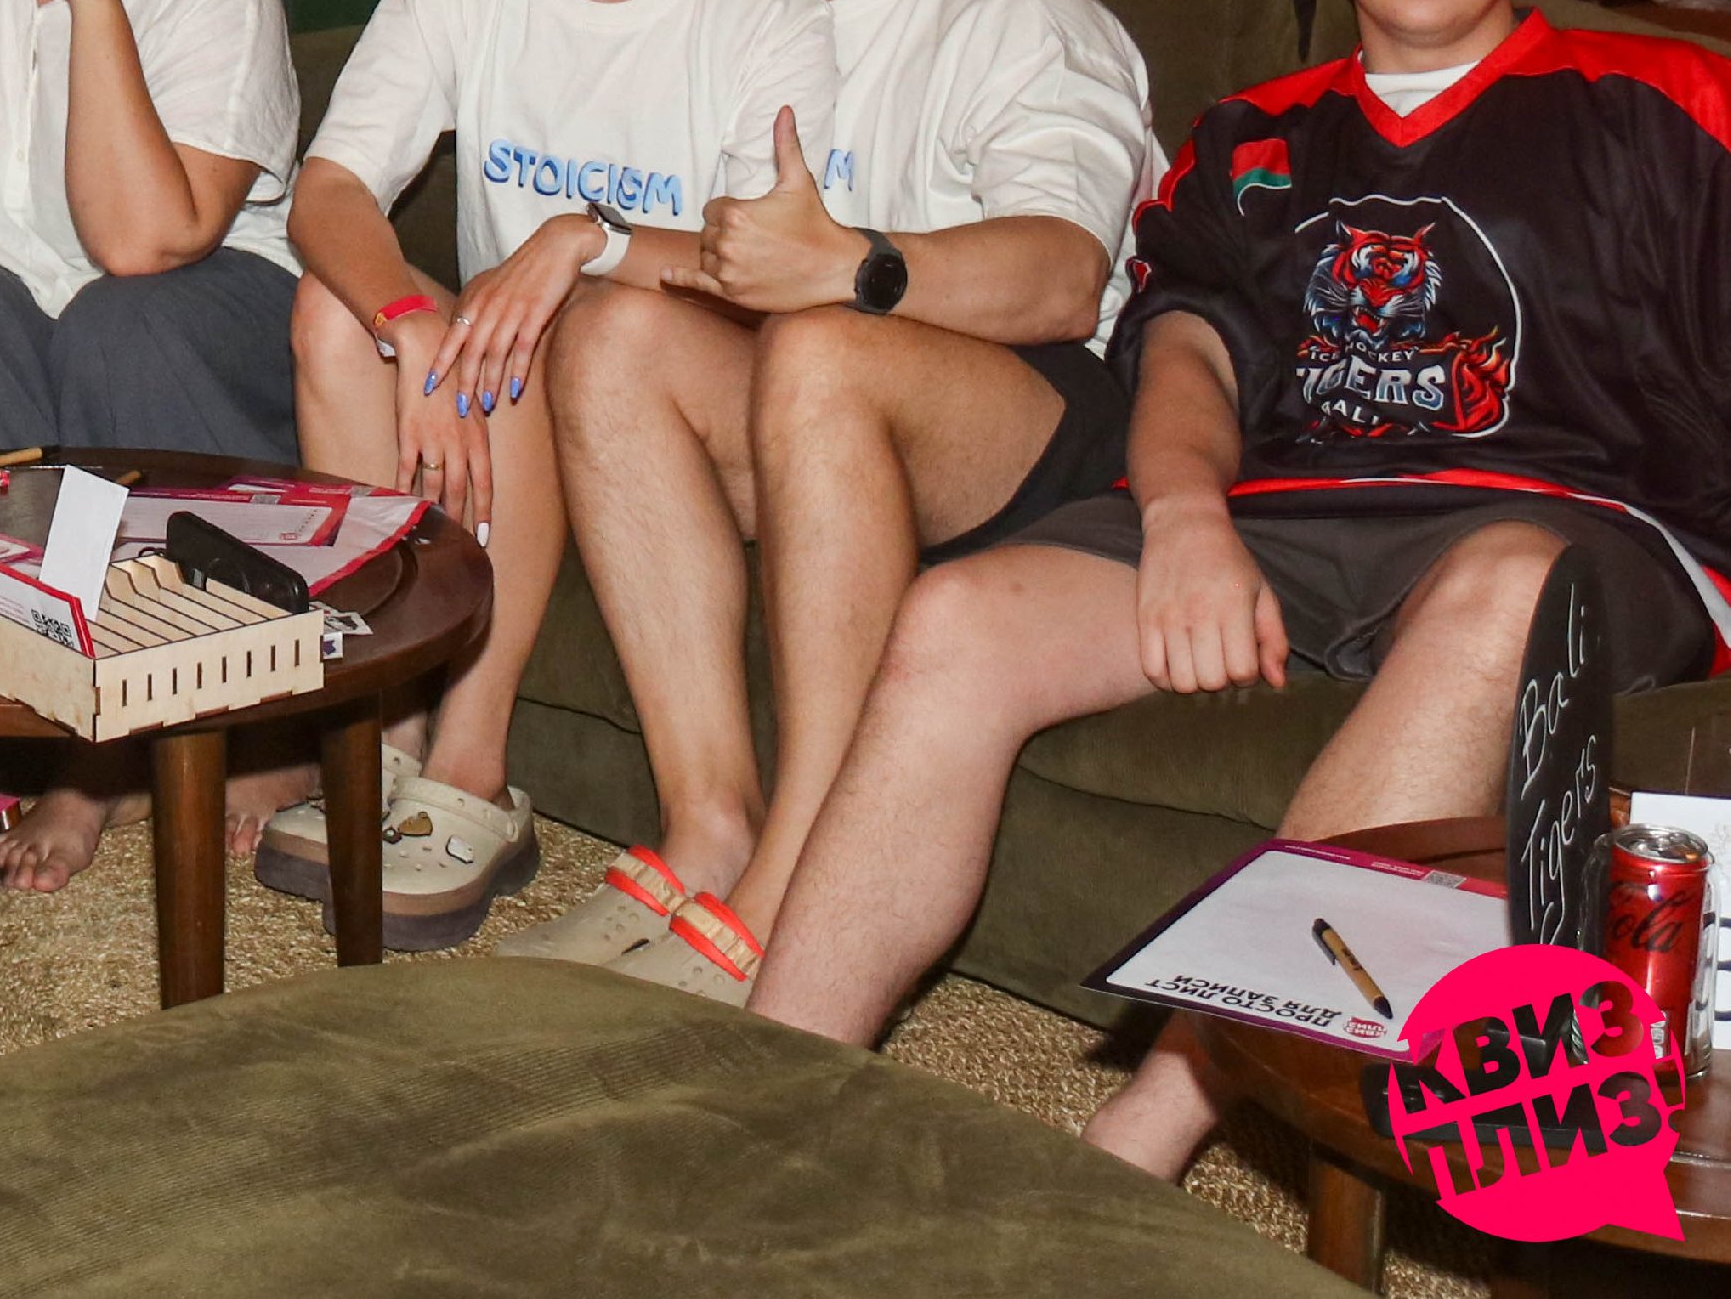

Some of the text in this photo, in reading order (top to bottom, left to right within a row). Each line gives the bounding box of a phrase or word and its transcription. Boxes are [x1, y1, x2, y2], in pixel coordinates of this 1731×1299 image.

[483, 138, 683, 216] STOICISM
[1520, 583, 1585, 801] Bali
[1520, 734, 1597, 944] Tigers
[1145, 978, 1331, 1028] ПРОСТО ЛИСТ
[1174, 974, 1343, 1020] ДЛЯ ЗАПИСИ
